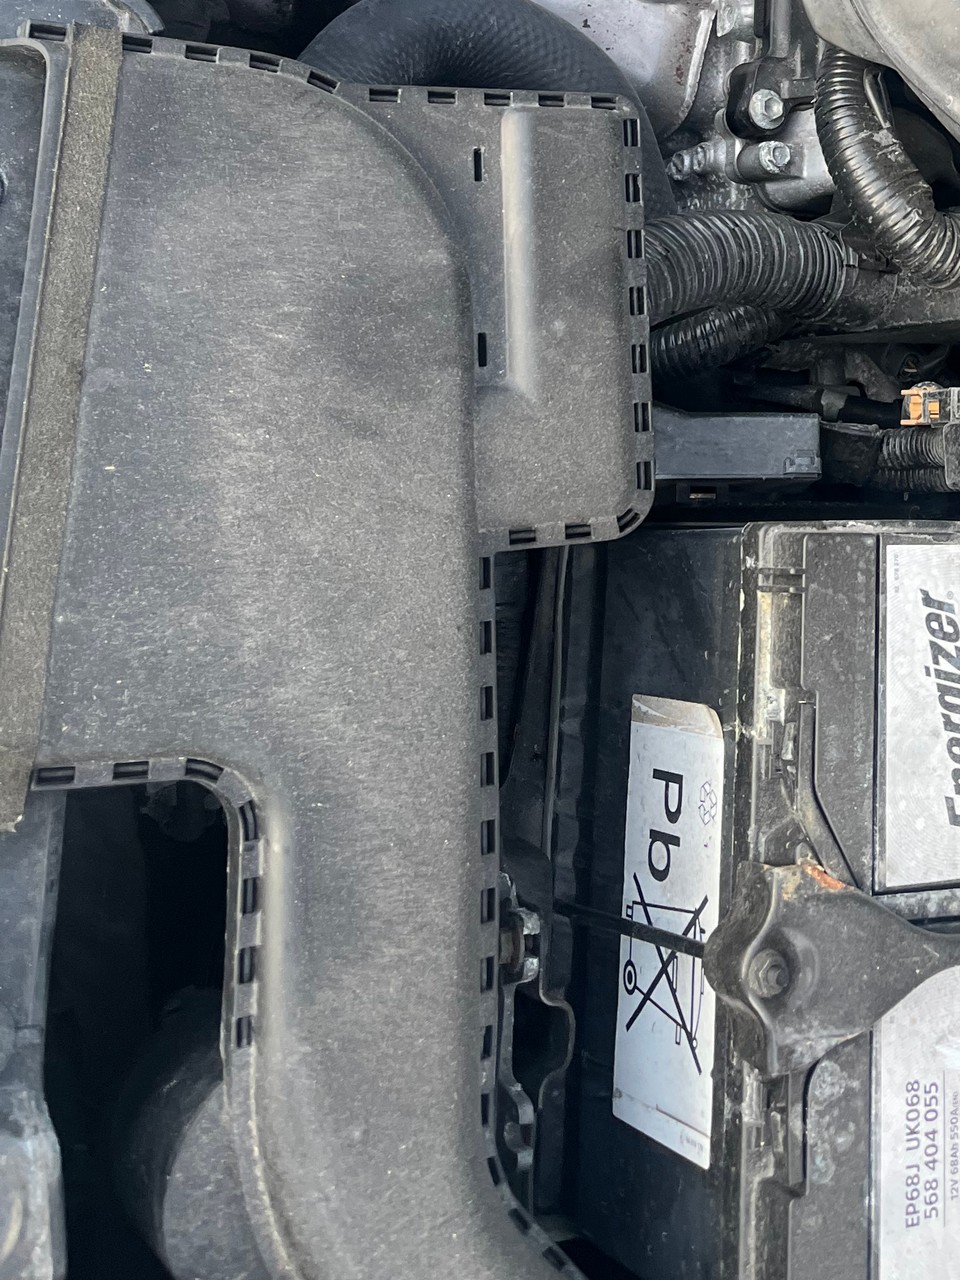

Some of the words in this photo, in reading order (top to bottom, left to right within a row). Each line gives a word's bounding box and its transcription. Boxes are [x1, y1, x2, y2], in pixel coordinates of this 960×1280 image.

[648, 768, 683, 882] Pb
[903, 1079, 922, 1151] UK068
[922, 1081, 939, 1121] 055
[922, 1128, 939, 1171] 404
[949, 1142, 959, 1174] 68Ah
[903, 1163, 922, 1228] EP68J
[922, 1177, 940, 1219] 568
[949, 1178, 959, 1200] 12V
